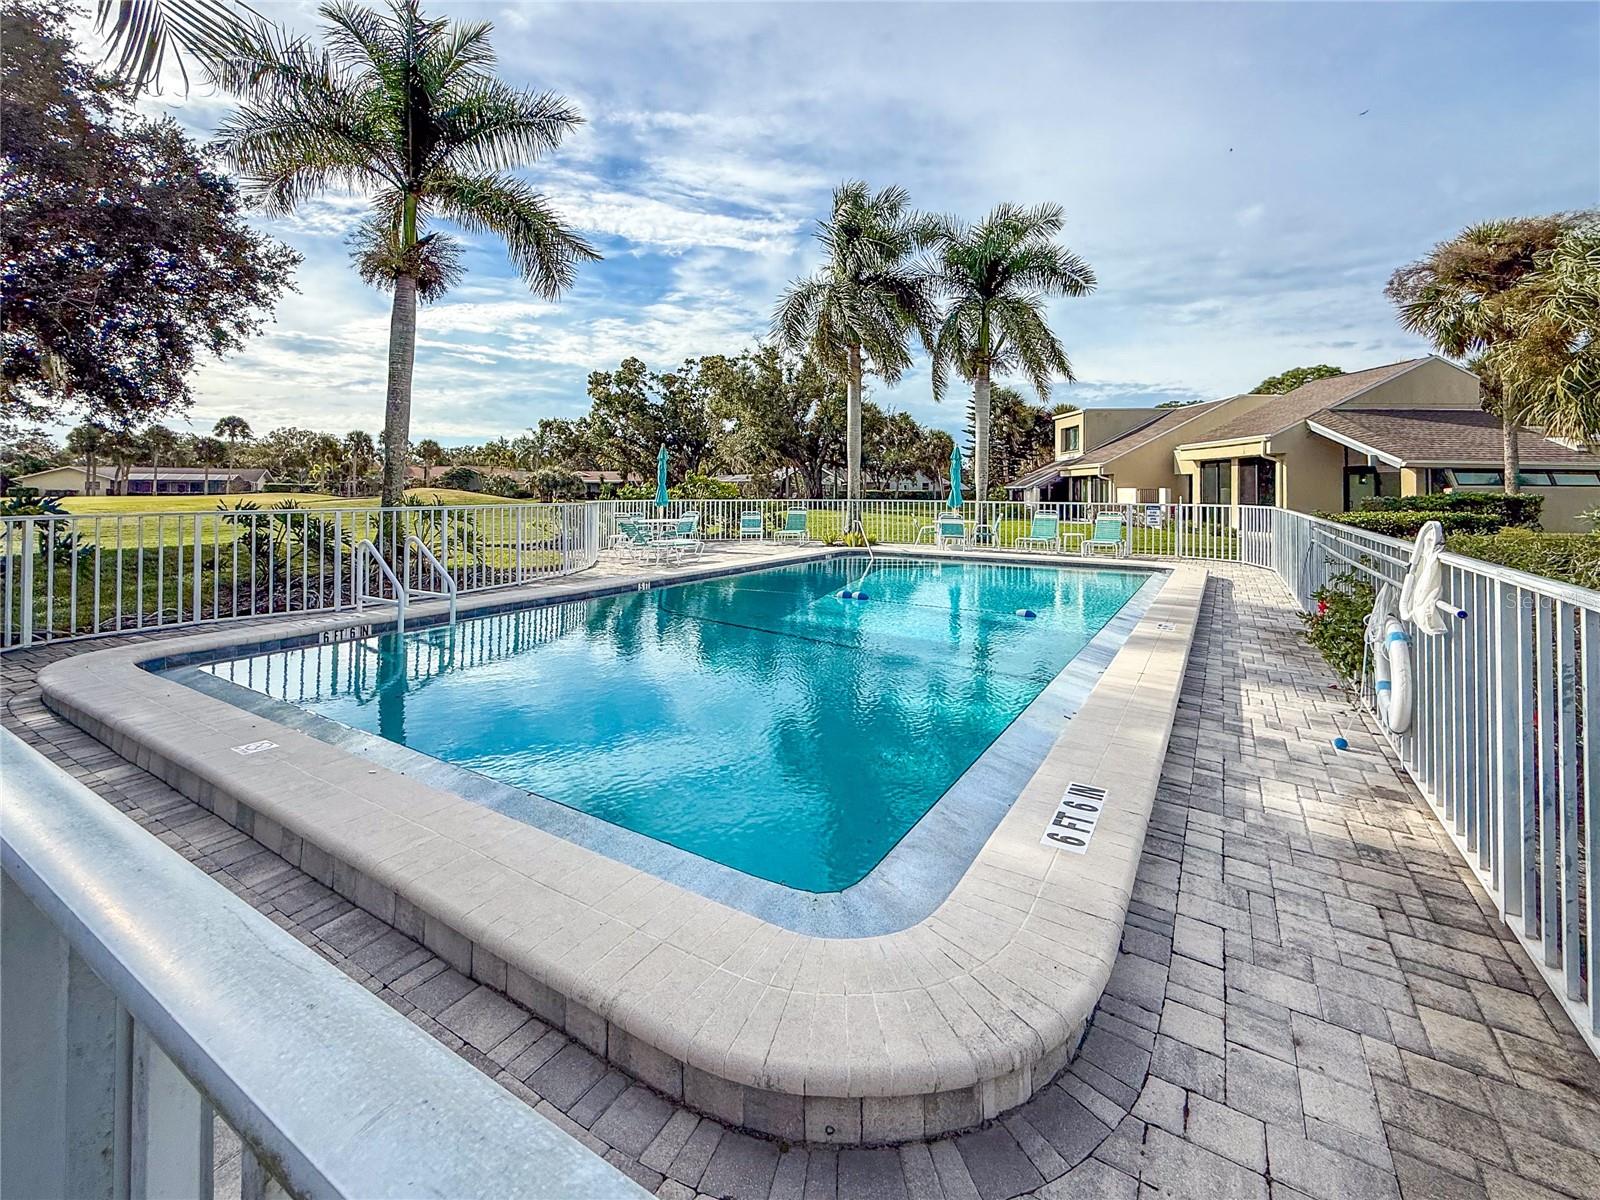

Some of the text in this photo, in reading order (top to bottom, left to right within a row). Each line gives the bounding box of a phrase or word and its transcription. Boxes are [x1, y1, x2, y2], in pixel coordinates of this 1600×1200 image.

[323, 624, 369, 643] 6 FT 6 IN
[1046, 783, 1106, 847] 6 FT 6 IN
